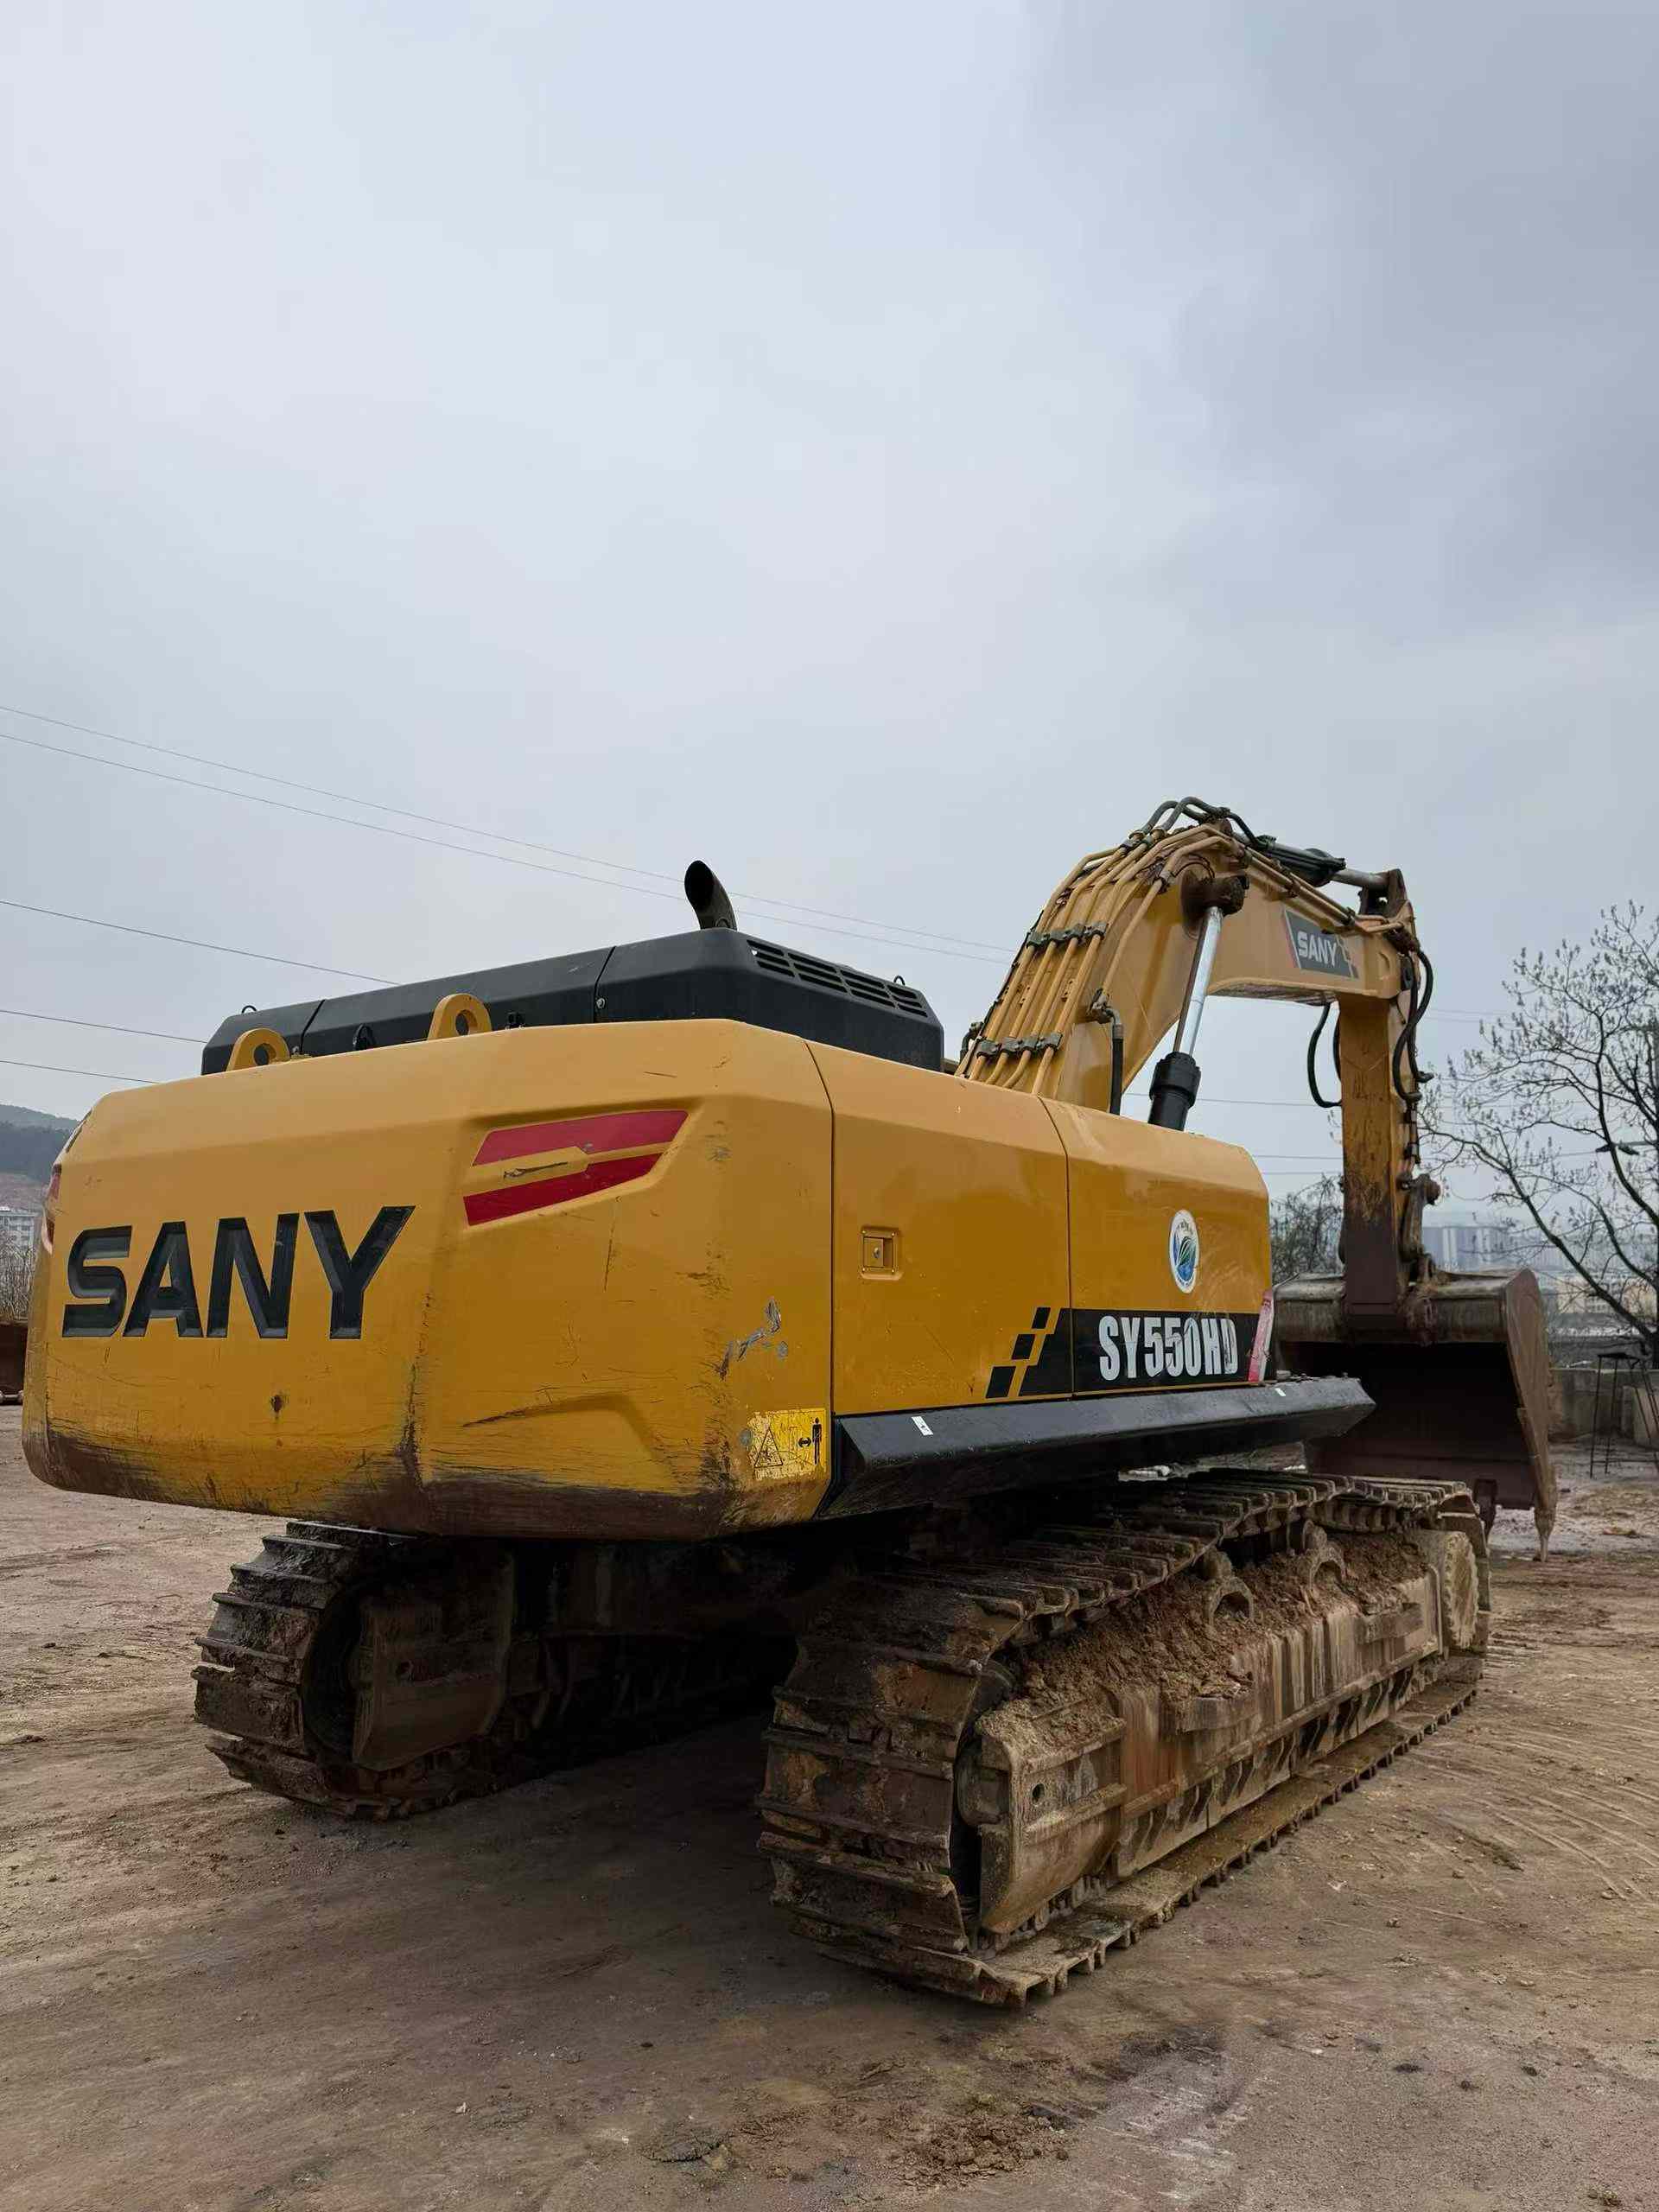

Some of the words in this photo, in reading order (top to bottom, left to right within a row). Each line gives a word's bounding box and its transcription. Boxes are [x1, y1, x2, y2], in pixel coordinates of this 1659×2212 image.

[1297, 931, 1337, 967] SANY
[62, 1205, 416, 1340] SANY
[1098, 1315, 1238, 1381] SY550HD
